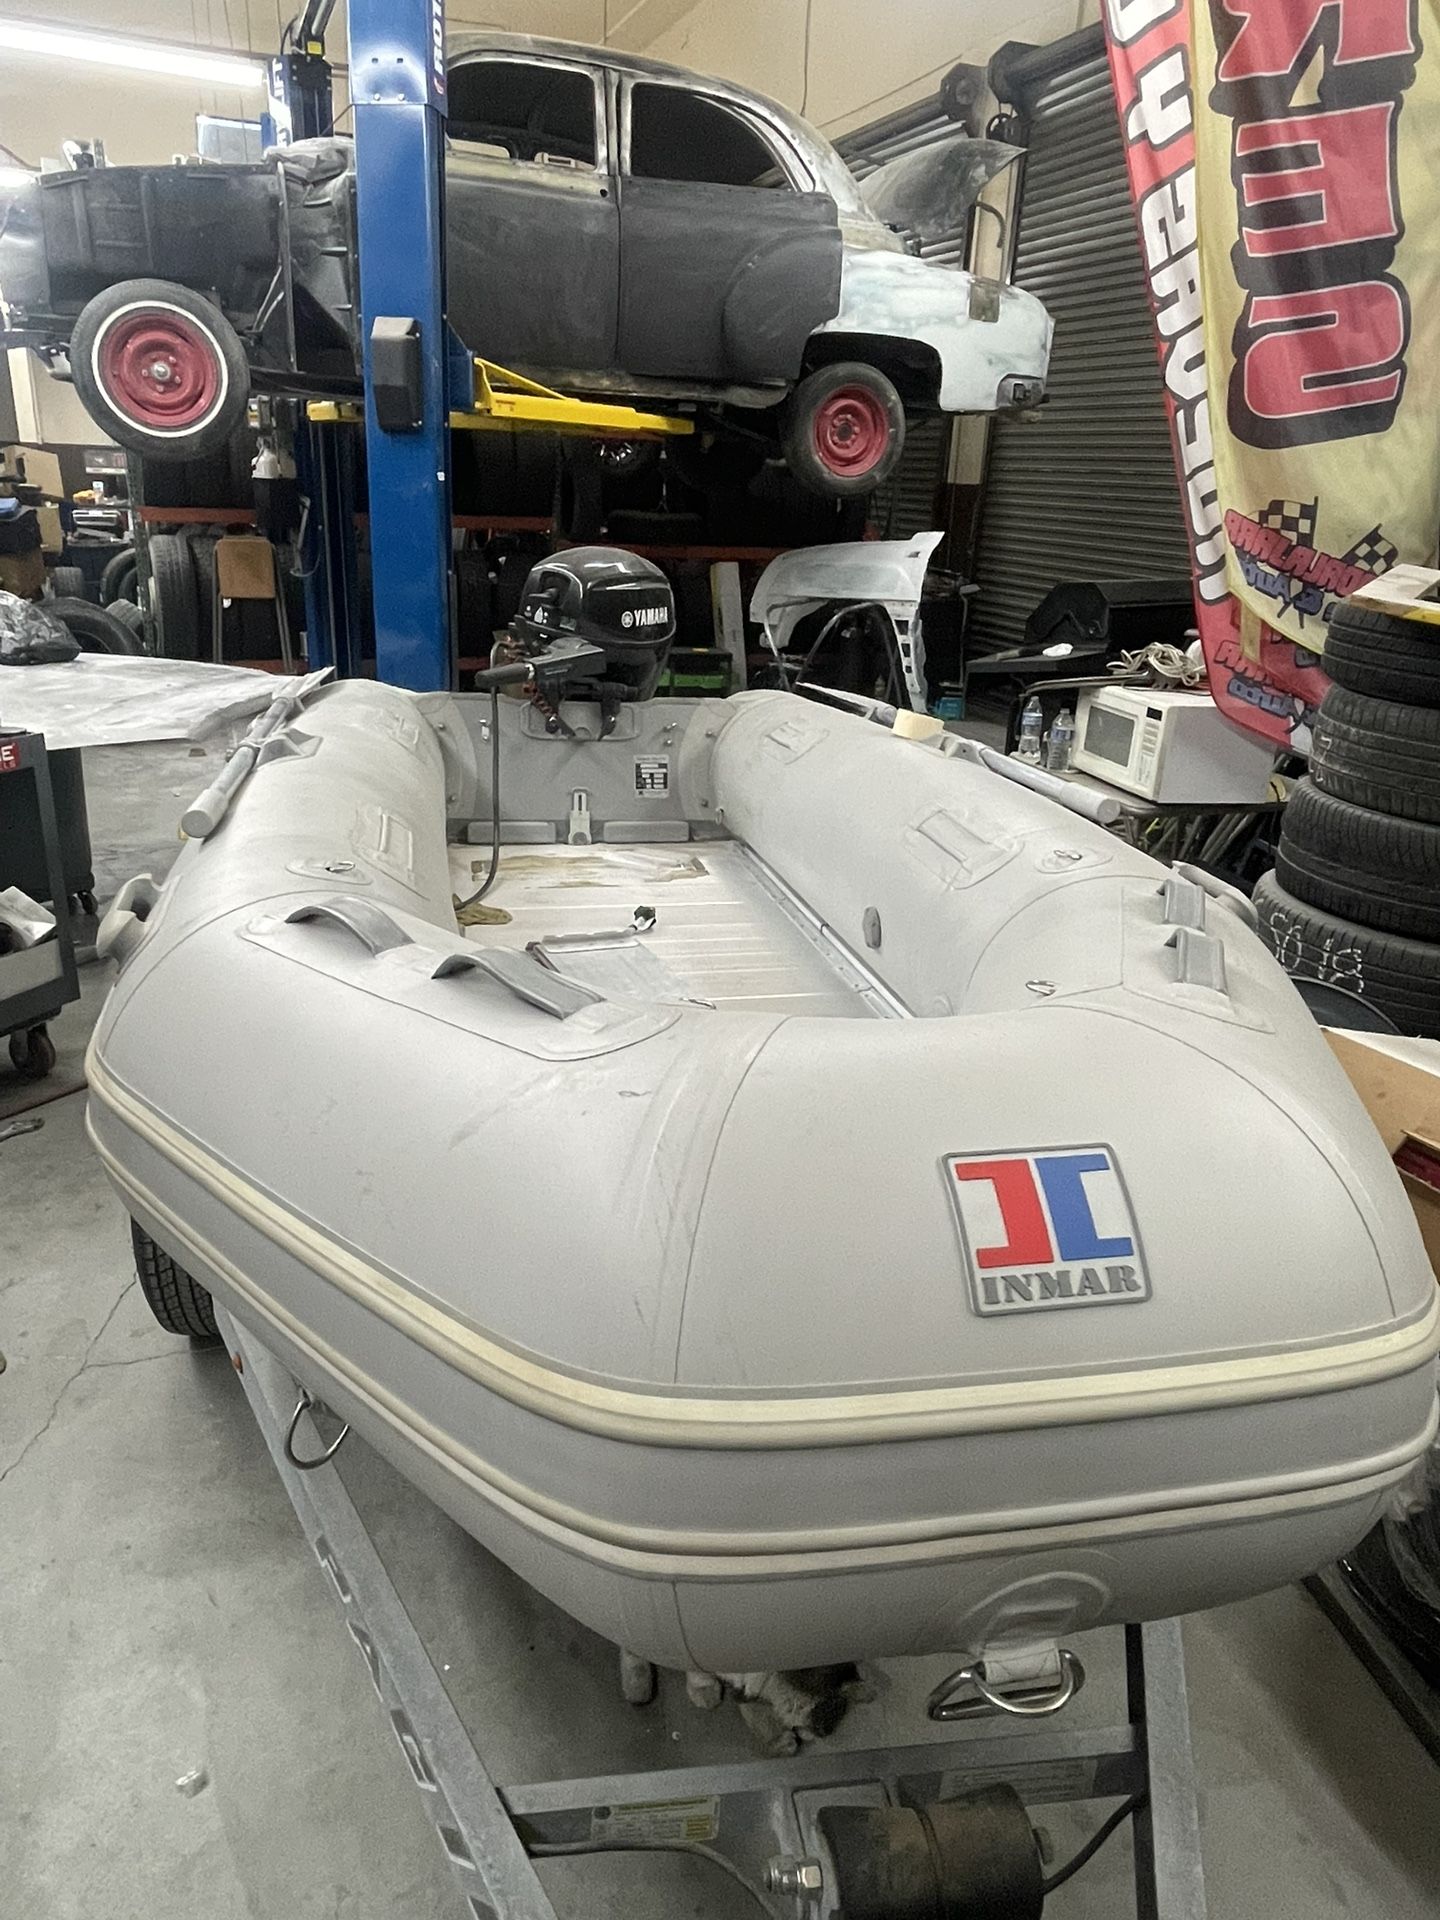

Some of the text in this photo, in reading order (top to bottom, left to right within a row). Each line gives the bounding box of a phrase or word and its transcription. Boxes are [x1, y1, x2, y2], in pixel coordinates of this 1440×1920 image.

[432, 0, 444, 75] ROT
[634, 606, 668, 627] YAMAHA
[981, 1264, 1142, 1305] INMAR
